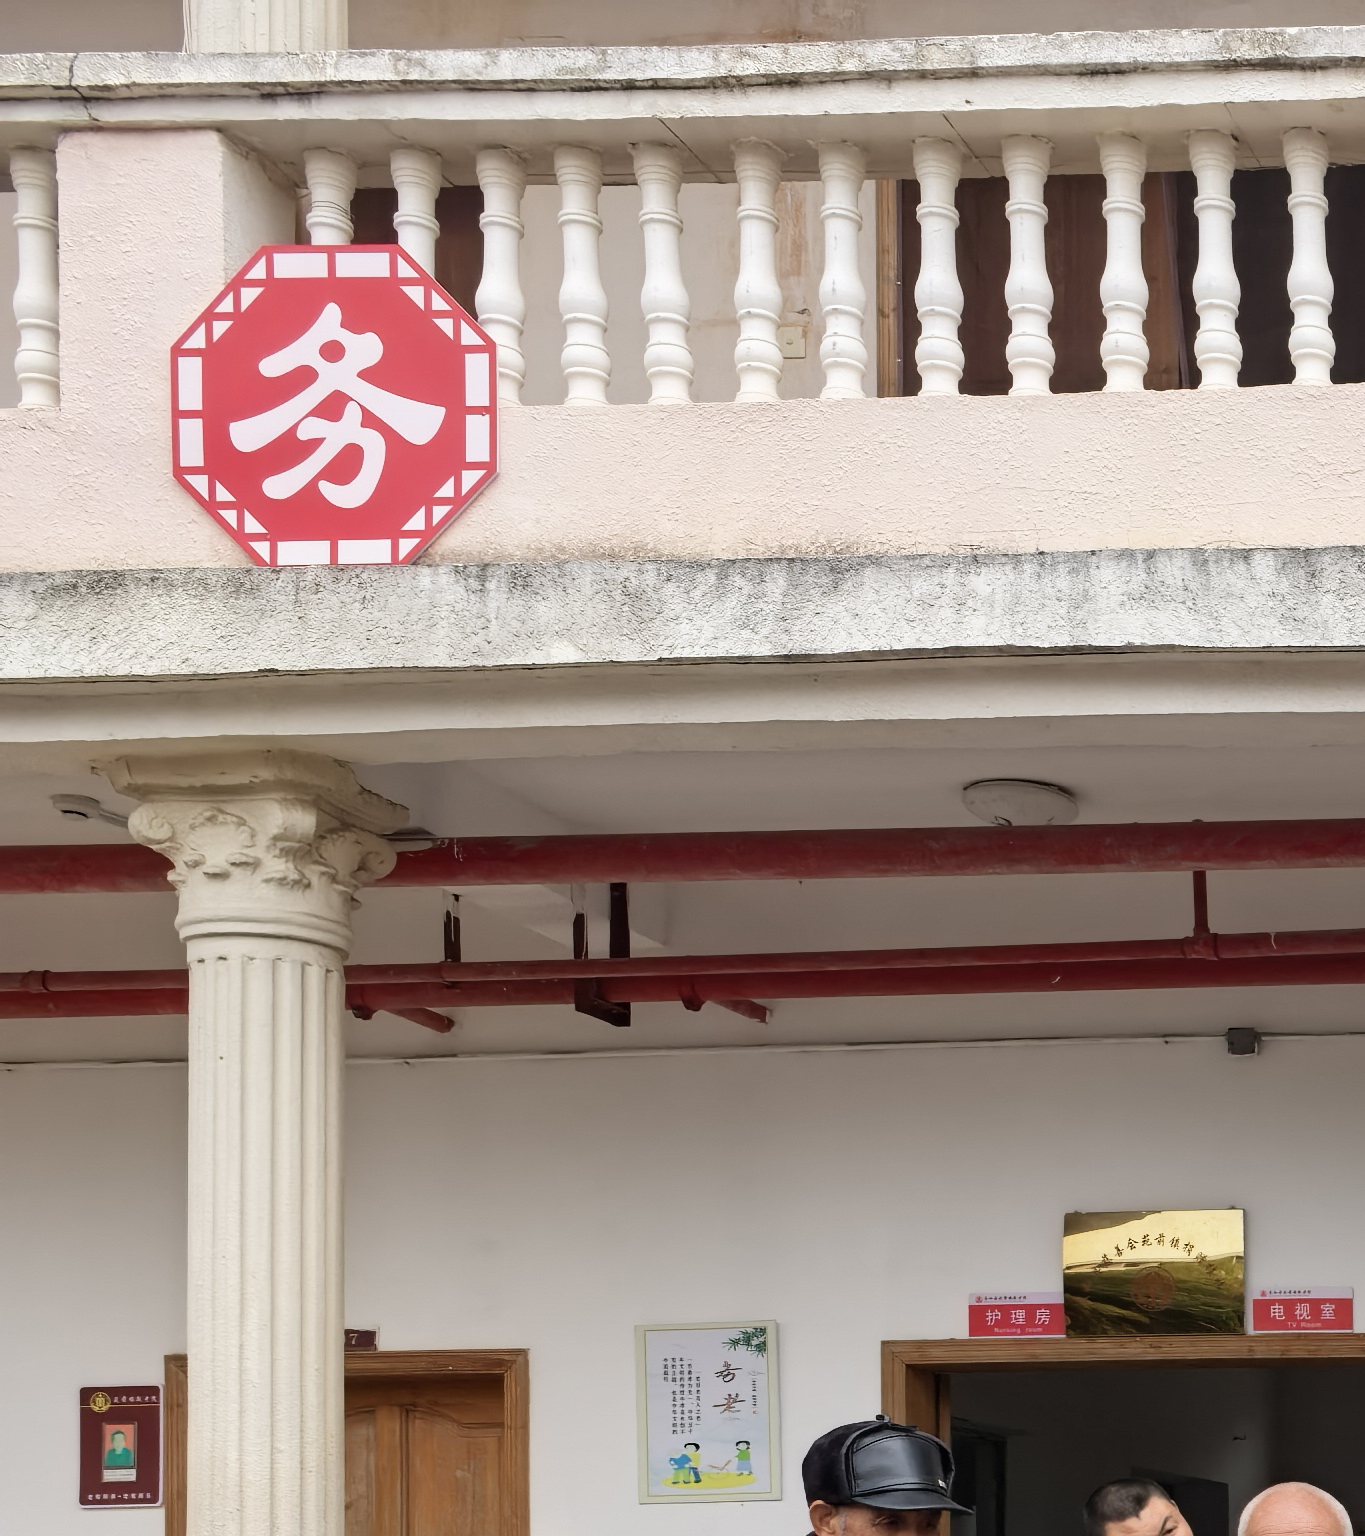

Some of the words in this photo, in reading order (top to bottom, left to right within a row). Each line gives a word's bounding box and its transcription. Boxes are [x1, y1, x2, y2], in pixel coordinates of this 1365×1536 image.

[229, 302, 446, 509] 务
[986, 1308, 1051, 1325] 护理房
[1270, 1302, 1335, 1320] 电视室
